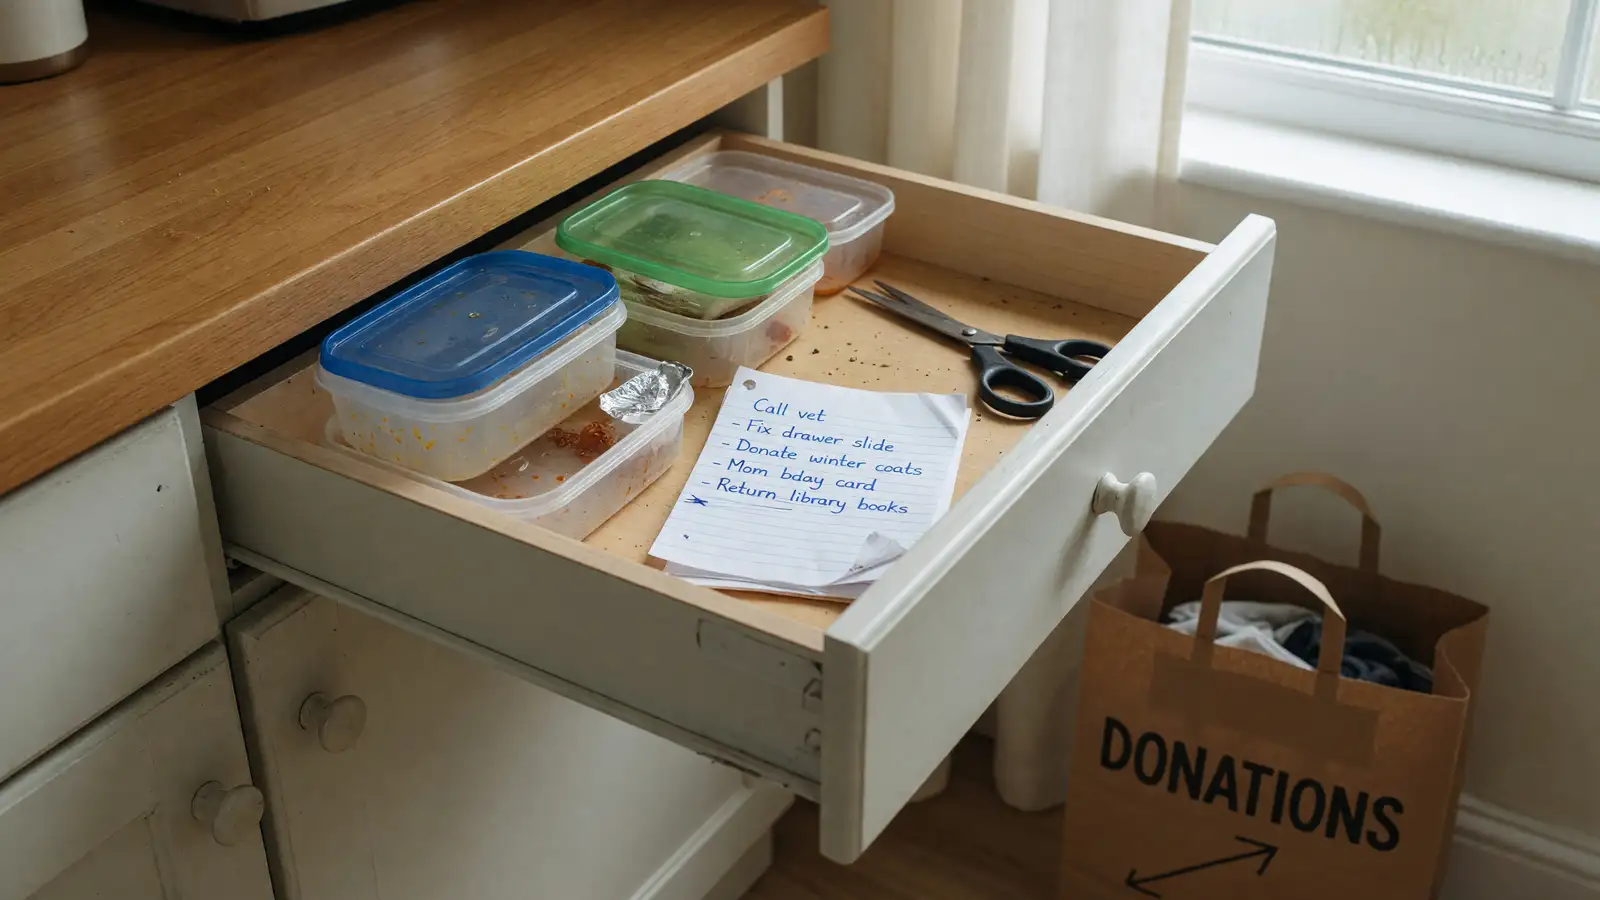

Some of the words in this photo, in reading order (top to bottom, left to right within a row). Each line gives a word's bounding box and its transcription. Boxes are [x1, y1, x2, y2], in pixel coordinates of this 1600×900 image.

[753, 398, 788, 417] Call
[798, 408, 828, 422] vet
[746, 419, 772, 435] Fix
[782, 426, 844, 446] drawer
[852, 436, 895, 453] slide
[736, 438, 798, 461] Donate
[809, 452, 867, 470] winter
[875, 460, 923, 476] coats
[727, 458, 768, 477] Mom
[780, 466, 825, 490] bday
[835, 478, 877, 492] card
[716, 478, 777, 501] Return
[789, 489, 847, 514] library
[857, 498, 908, 514] books
[1100, 716, 1404, 852] DONATIONS
